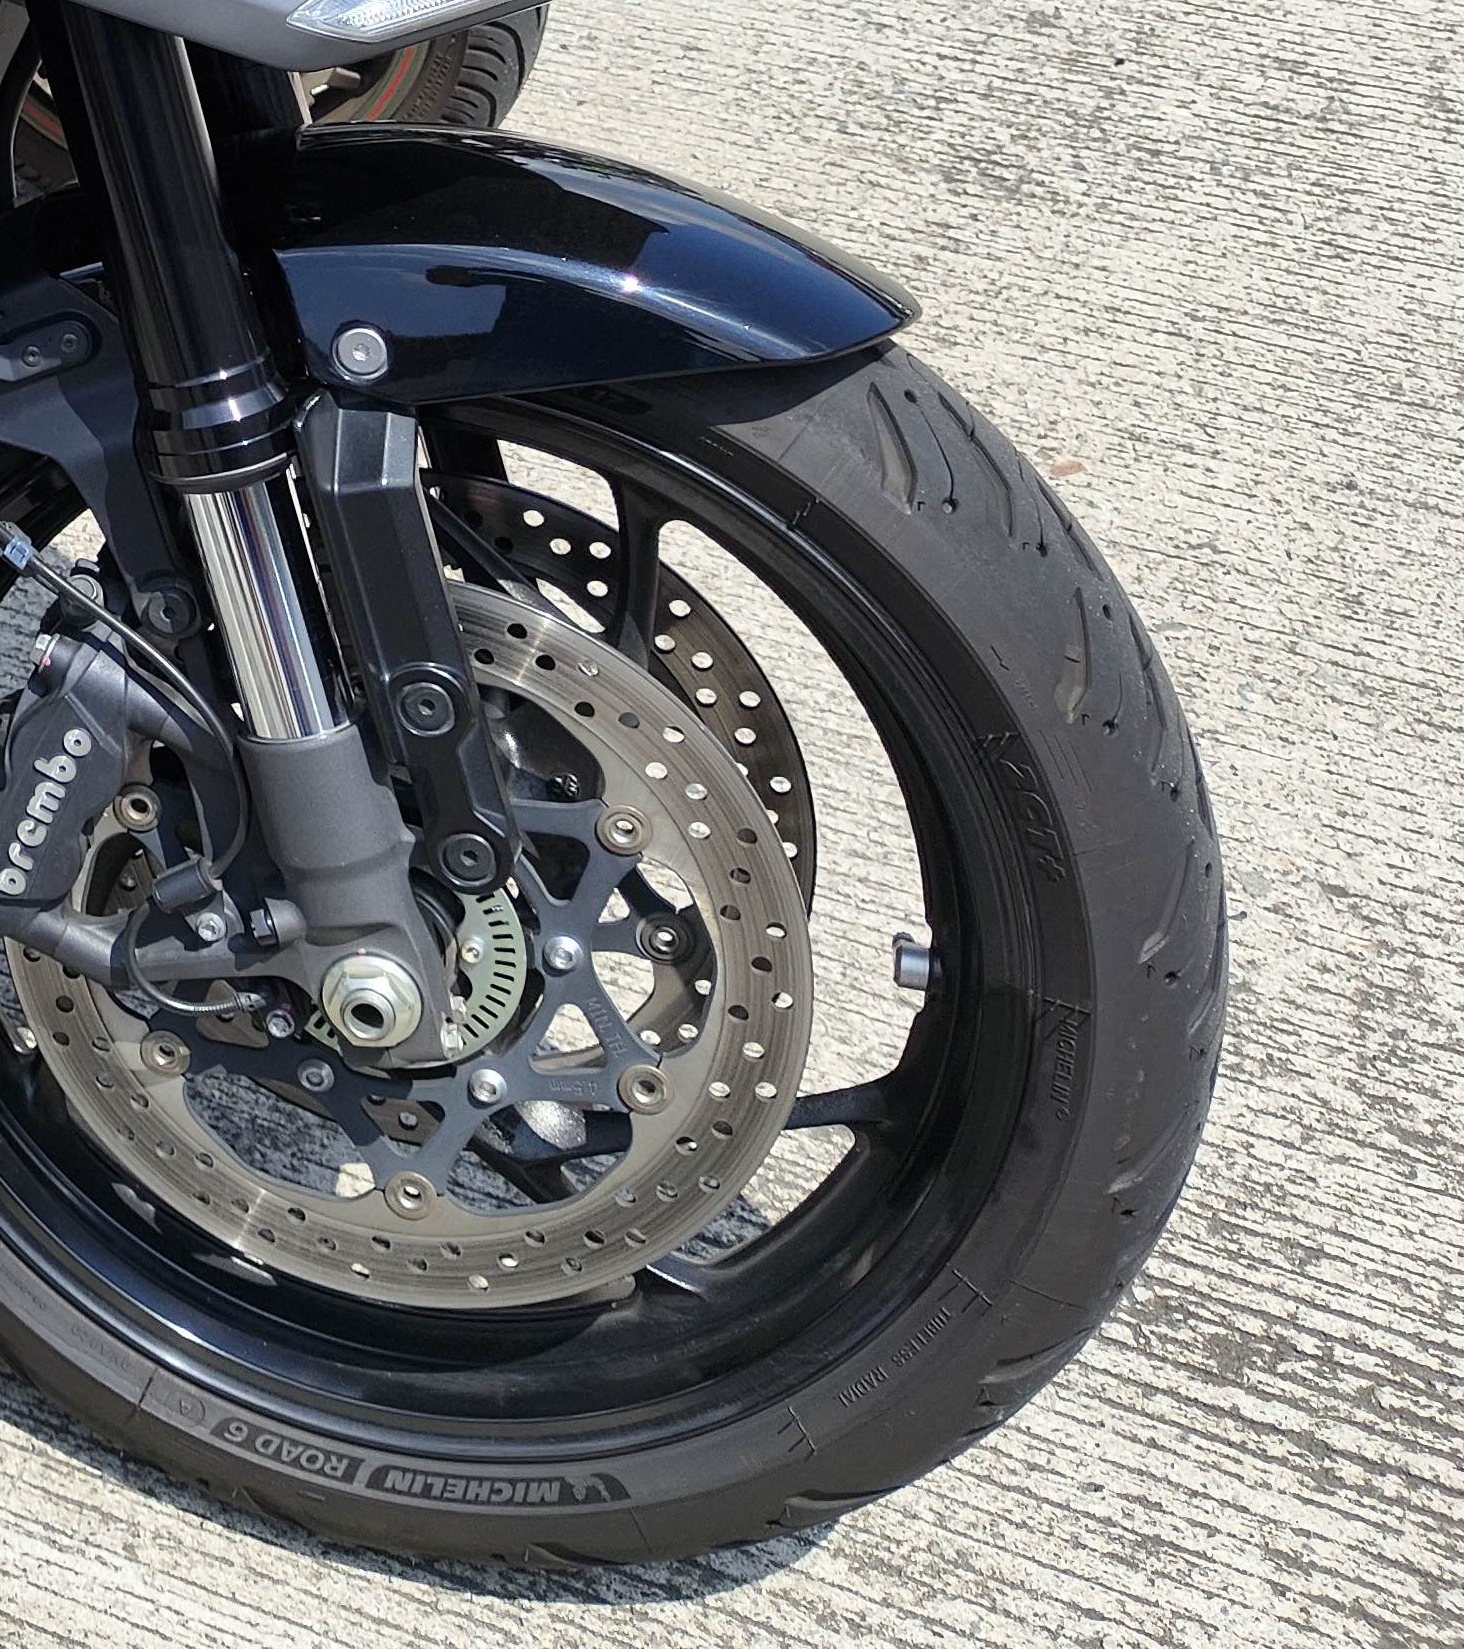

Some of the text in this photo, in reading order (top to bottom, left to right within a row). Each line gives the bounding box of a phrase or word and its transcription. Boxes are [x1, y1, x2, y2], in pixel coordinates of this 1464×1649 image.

[1052, 1018, 1079, 1105] MICHELIN
[223, 1421, 562, 1504] MICHELIN ROAD 6
